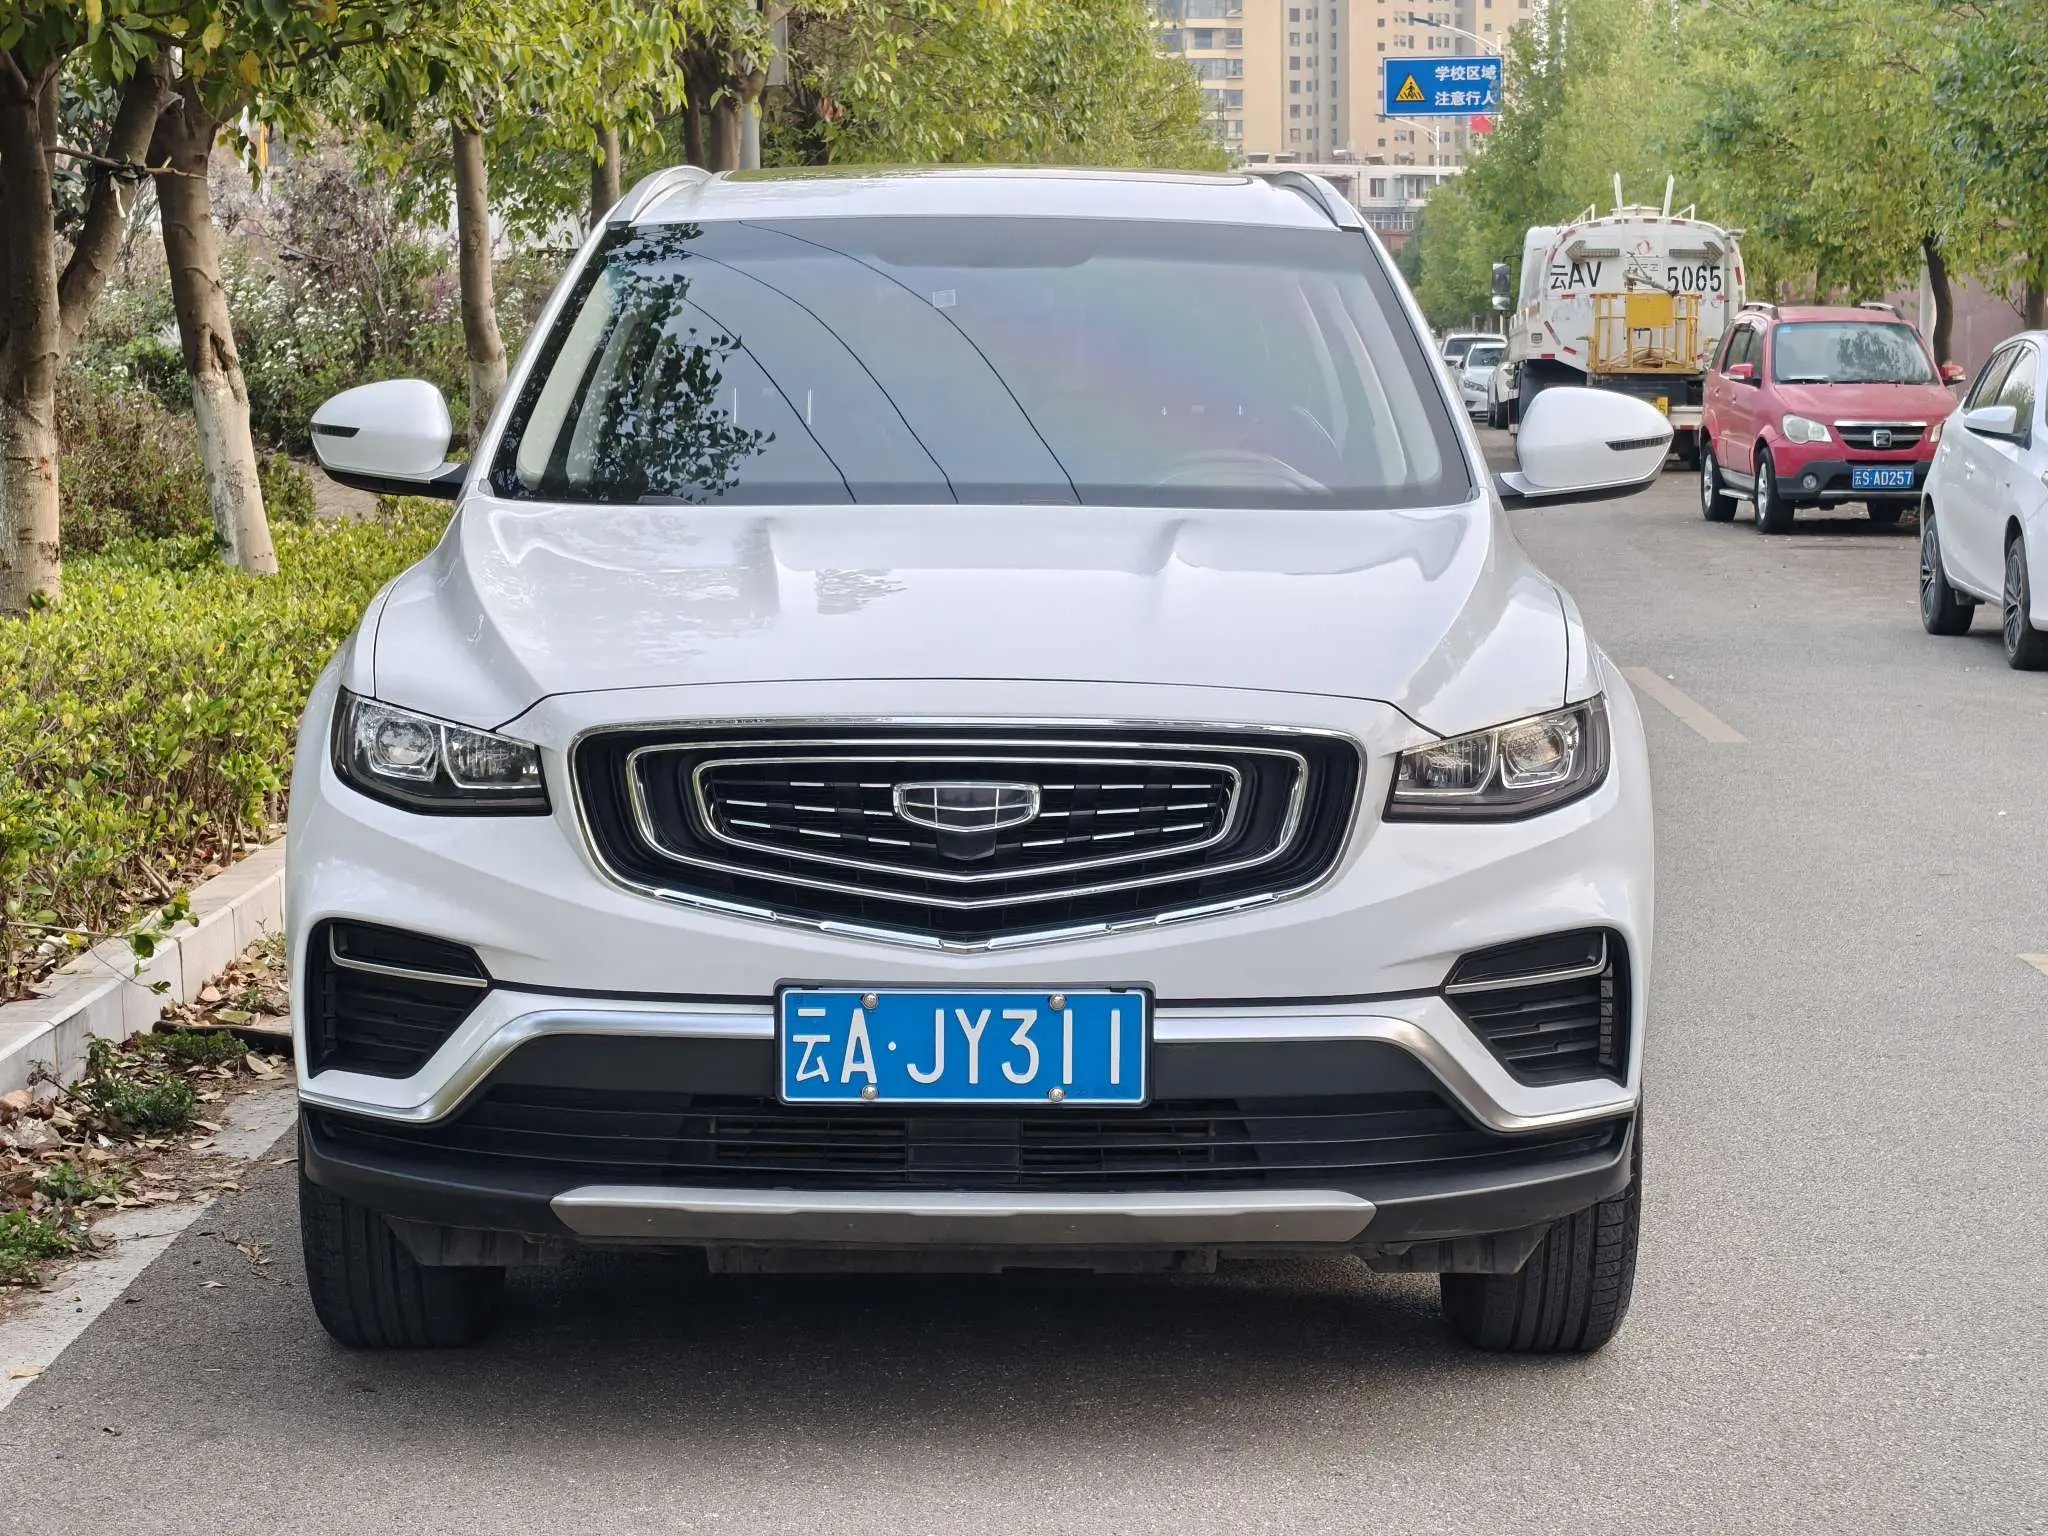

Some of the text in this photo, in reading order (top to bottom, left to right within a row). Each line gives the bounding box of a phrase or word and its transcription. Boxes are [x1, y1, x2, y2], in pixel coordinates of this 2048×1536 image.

[1434, 65, 1497, 81] 学校区域
[1434, 91, 1497, 106] 注意行人
[1550, 261, 1722, 293] 云AV 5065
